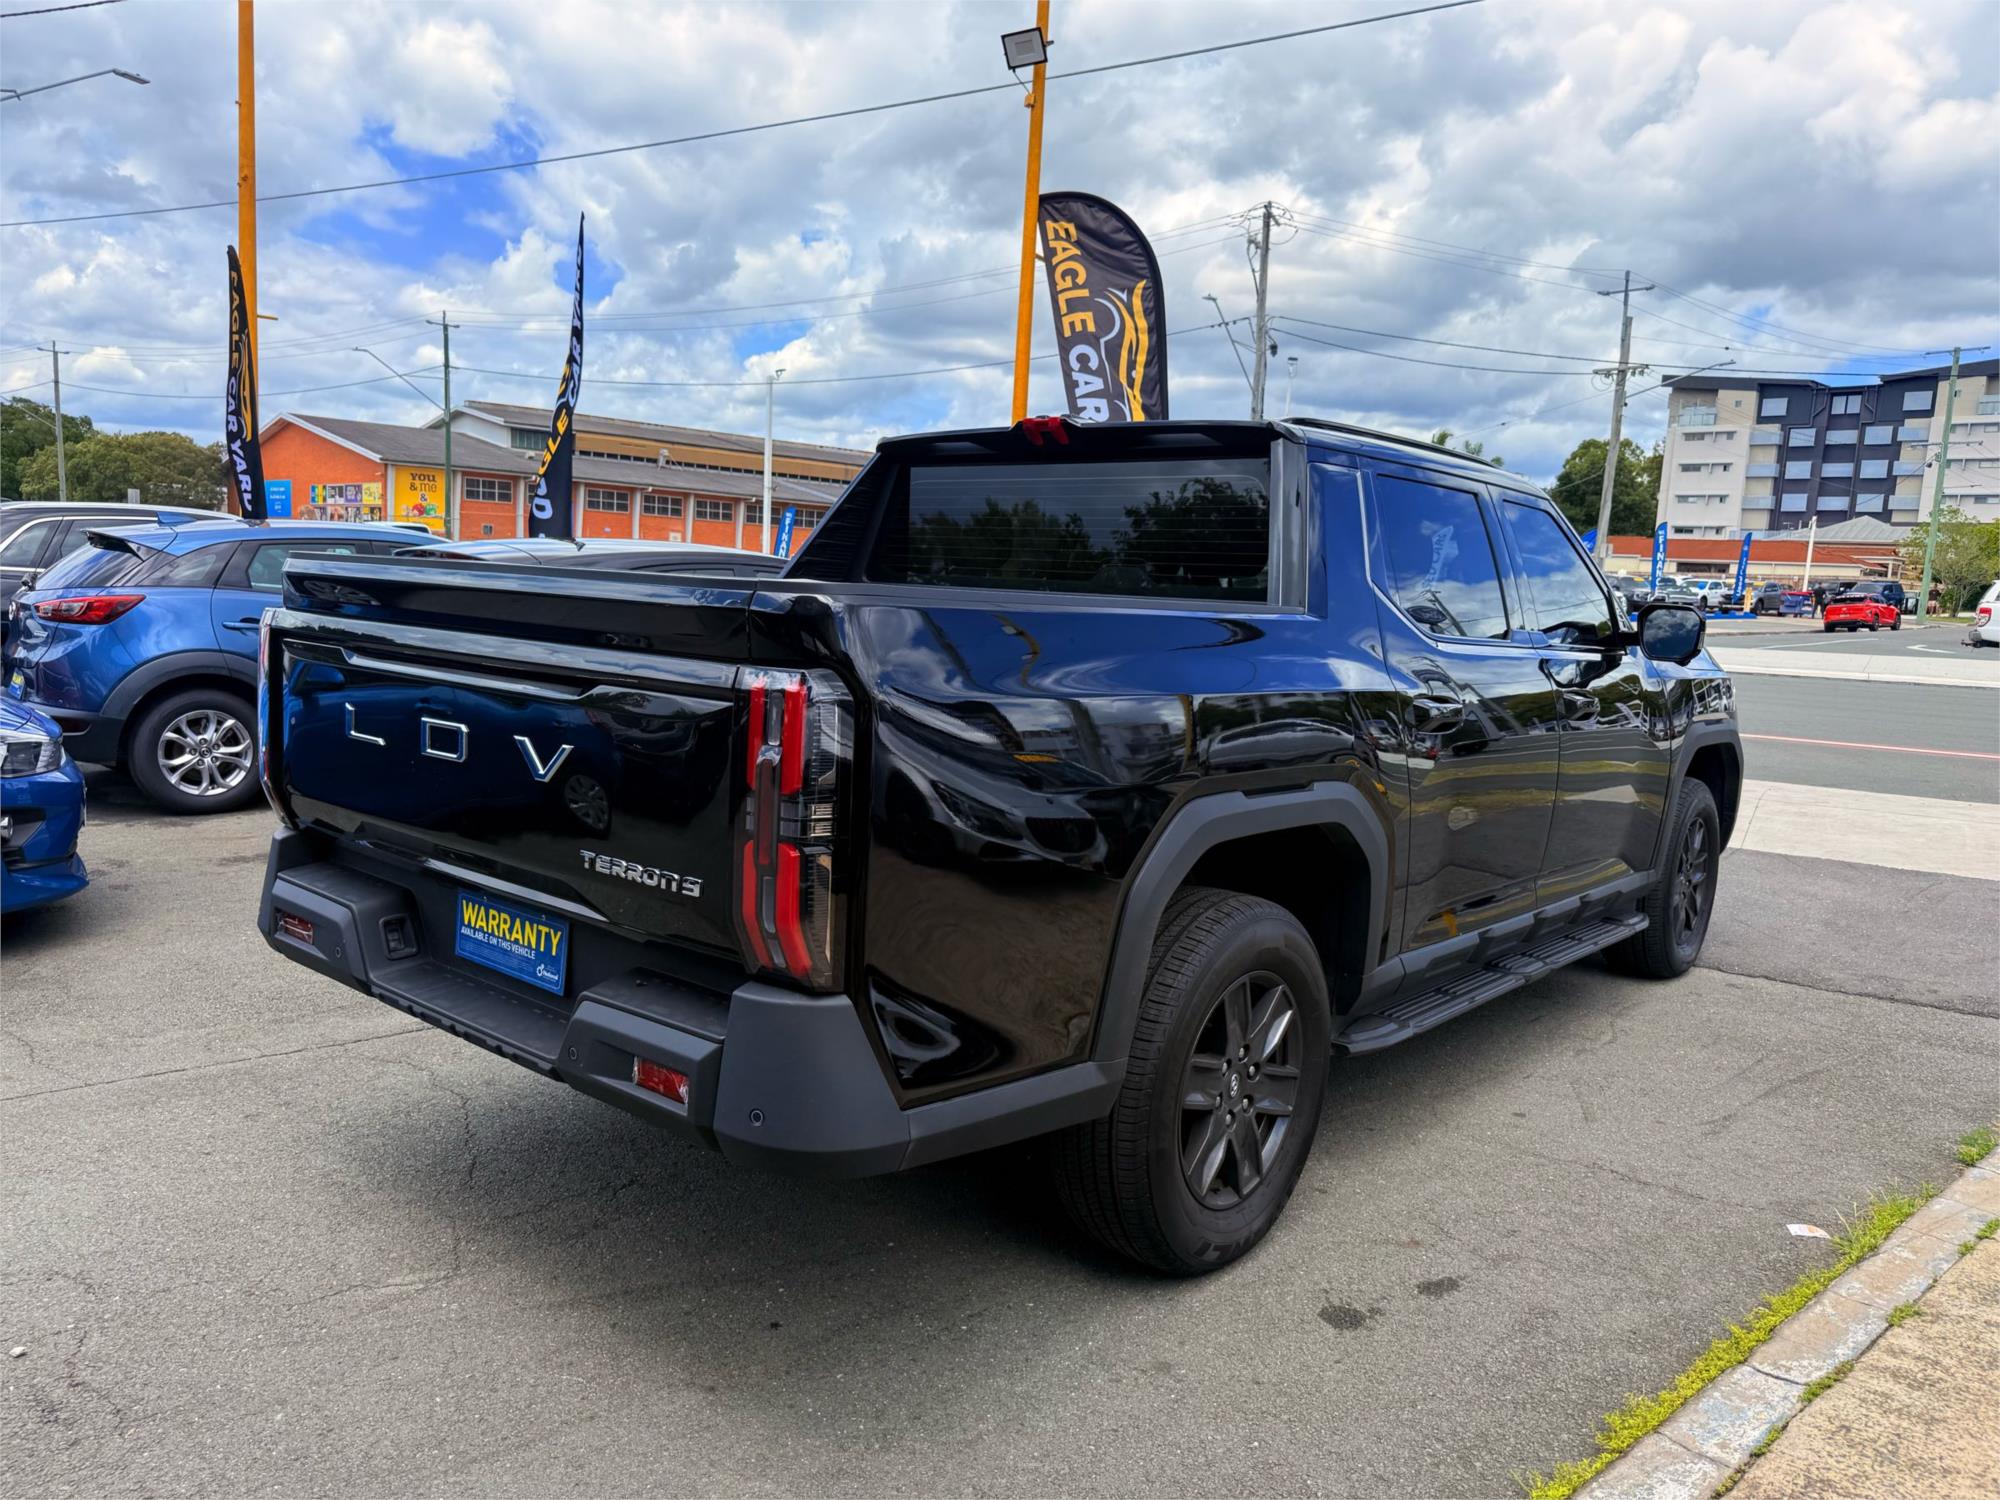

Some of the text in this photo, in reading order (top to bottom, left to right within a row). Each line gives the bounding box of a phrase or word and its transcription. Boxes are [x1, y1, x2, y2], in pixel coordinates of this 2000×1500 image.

[1045, 220, 1110, 422] EAGLE CAR
[568, 336, 581, 407] CAR
[228, 376, 238, 433] CAR
[538, 408, 569, 476] GLE
[409, 482, 418, 491] &
[421, 493, 428, 501] &
[1655, 535, 1666, 593] FINANC
[345, 703, 575, 782] LDV
[461, 927, 536, 959] AVAILABLE ON THIS VEHICLE
[463, 900, 561, 956] WARRANTY
